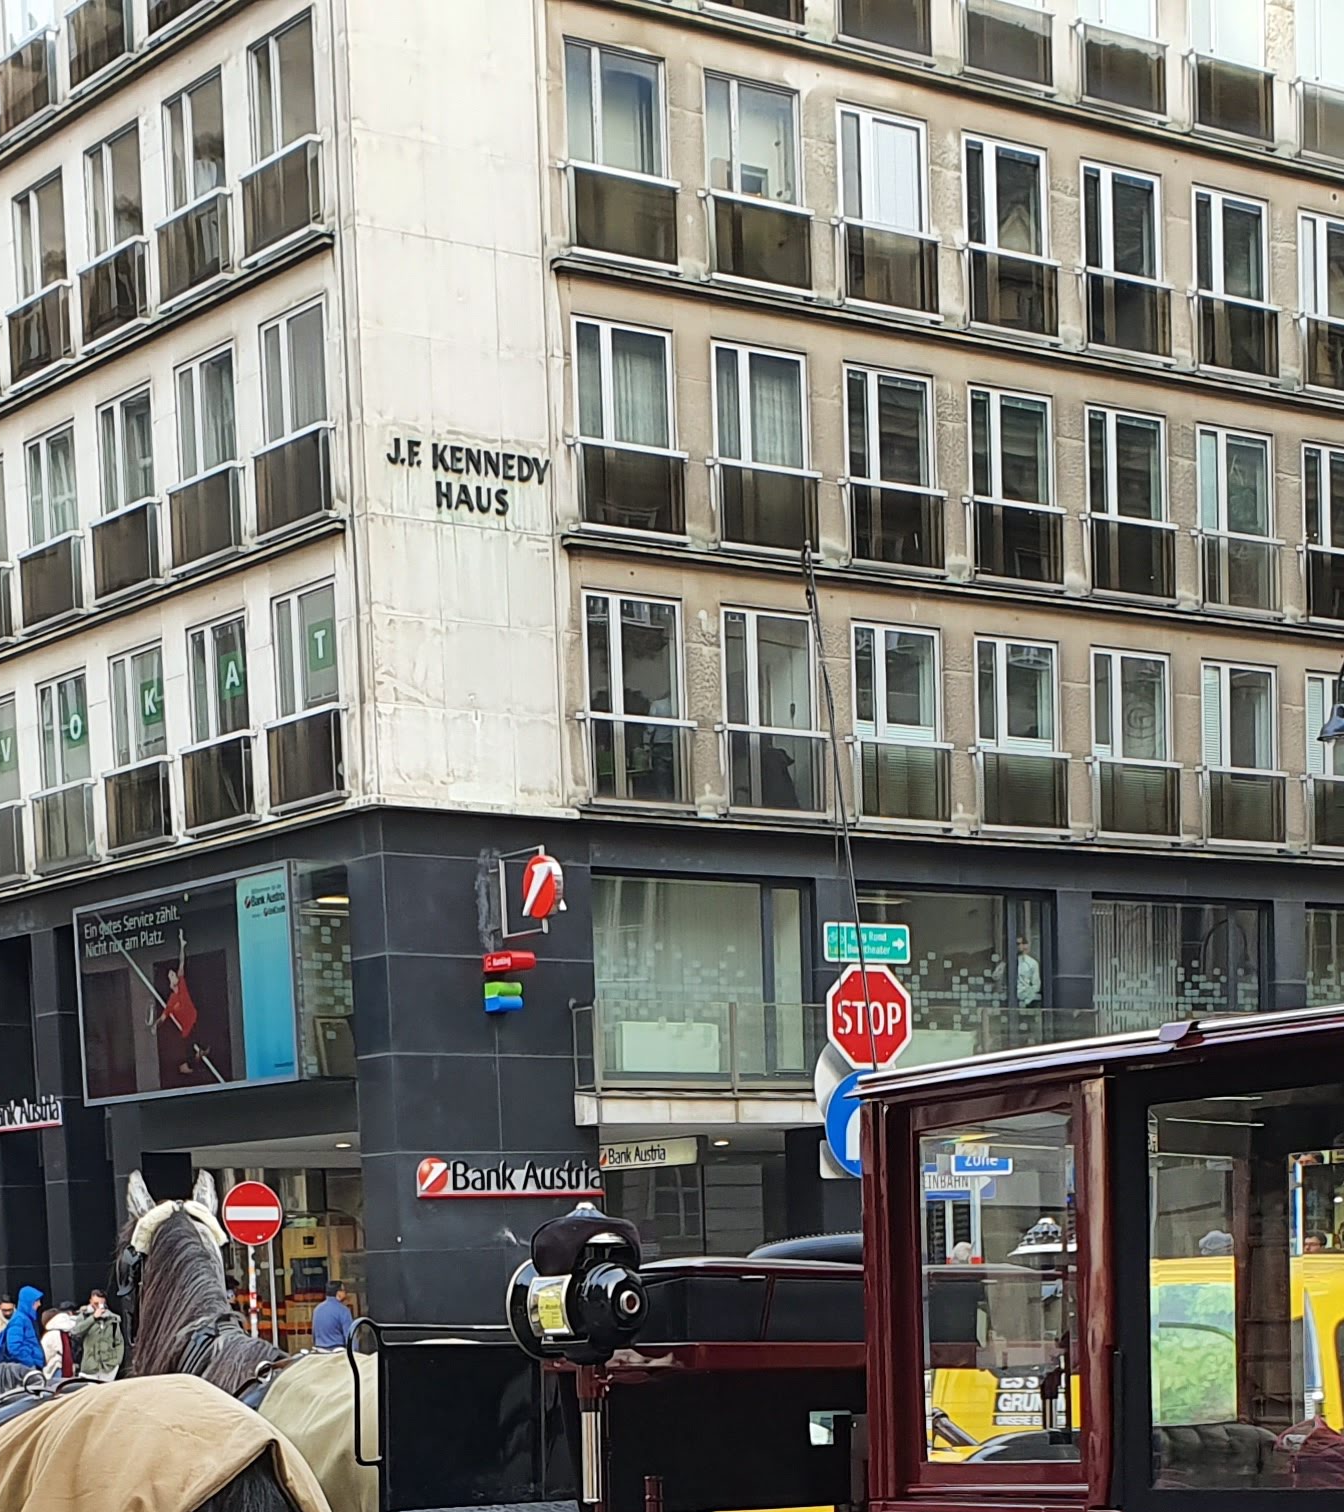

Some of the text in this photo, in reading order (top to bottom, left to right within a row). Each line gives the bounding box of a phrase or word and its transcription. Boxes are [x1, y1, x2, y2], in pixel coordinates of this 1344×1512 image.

[386, 437, 550, 485] J.F. KENNEDY
[435, 481, 510, 516] HAUS
[83, 923, 98, 940] Ein
[123, 911, 154, 932] Service
[85, 940, 108, 959] Nicht
[124, 935, 139, 951] am
[837, 1000, 902, 1037] STOP
[19, 1094, 60, 1123] Austria
[608, 1143, 667, 1165] Bank Austria
[451, 1158, 602, 1191] Bank Austria
